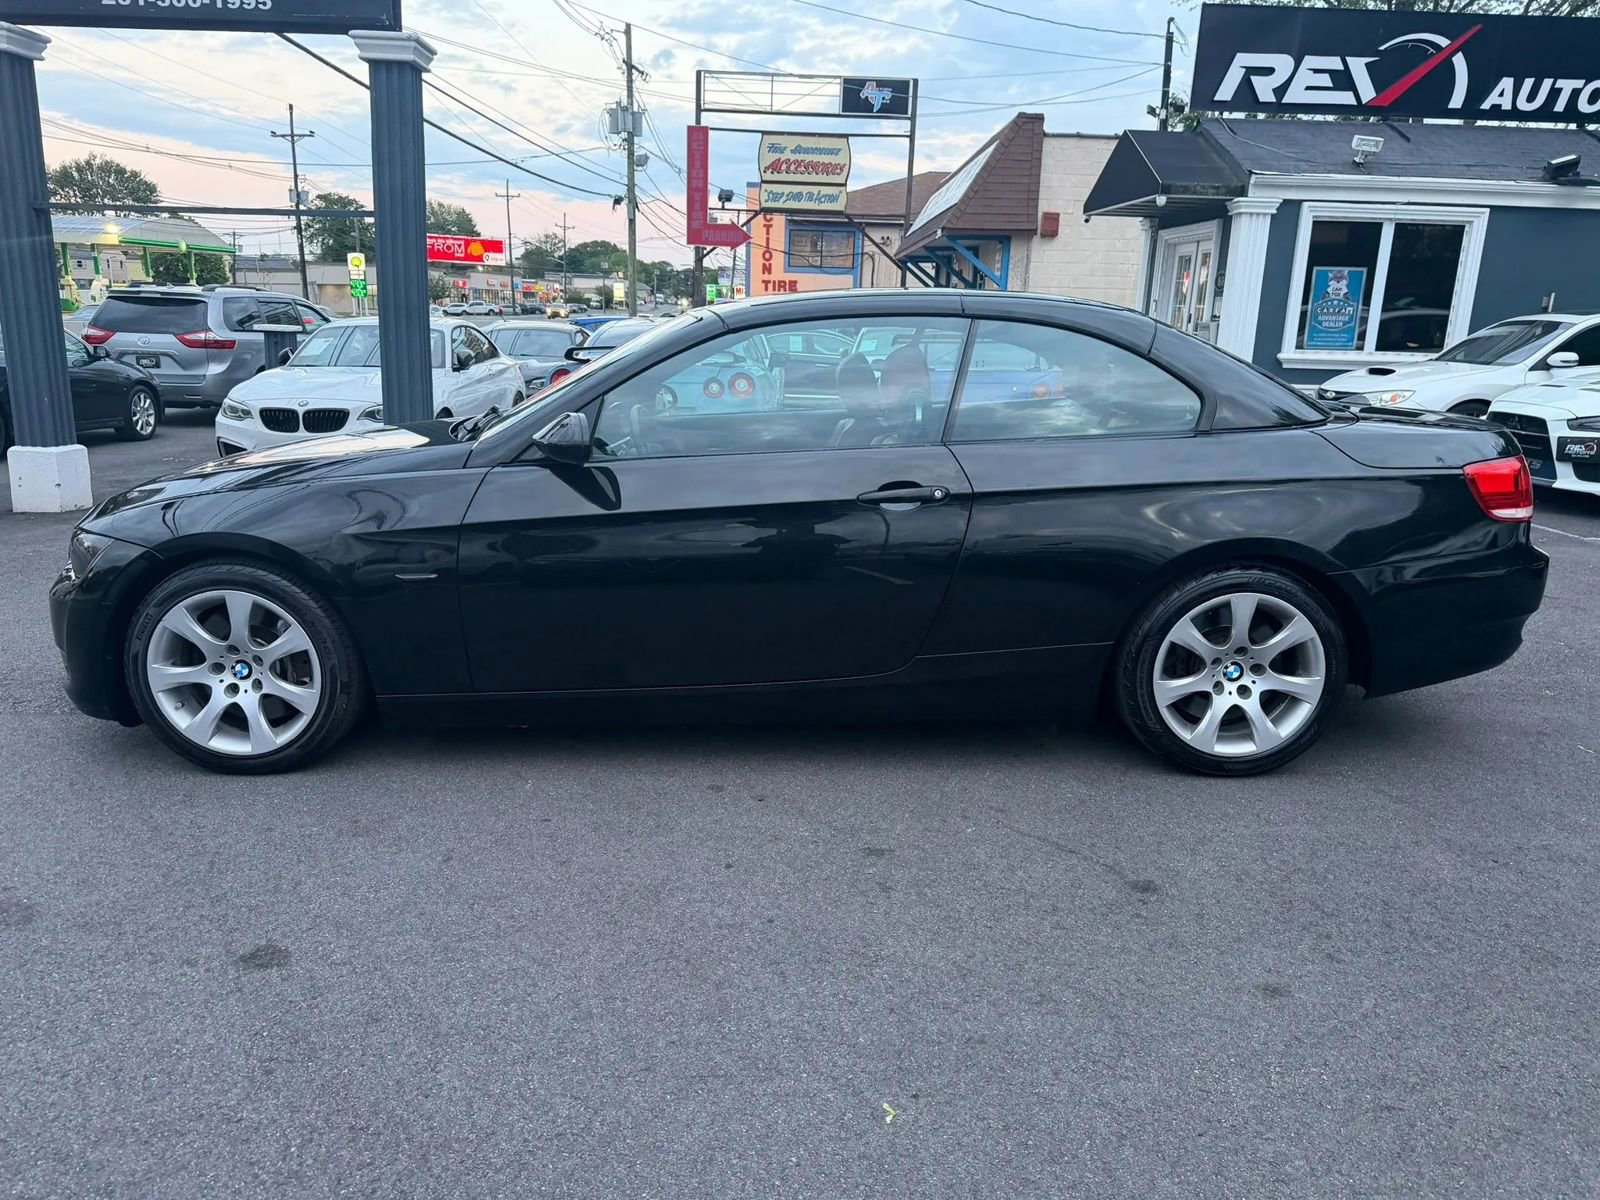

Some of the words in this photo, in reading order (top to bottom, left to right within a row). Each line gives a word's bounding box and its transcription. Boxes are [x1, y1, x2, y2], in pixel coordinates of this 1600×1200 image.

[1480, 77, 1600, 114] AUTO
[763, 157, 847, 176] ACCESSORIES
[761, 280, 798, 292] TIRE
